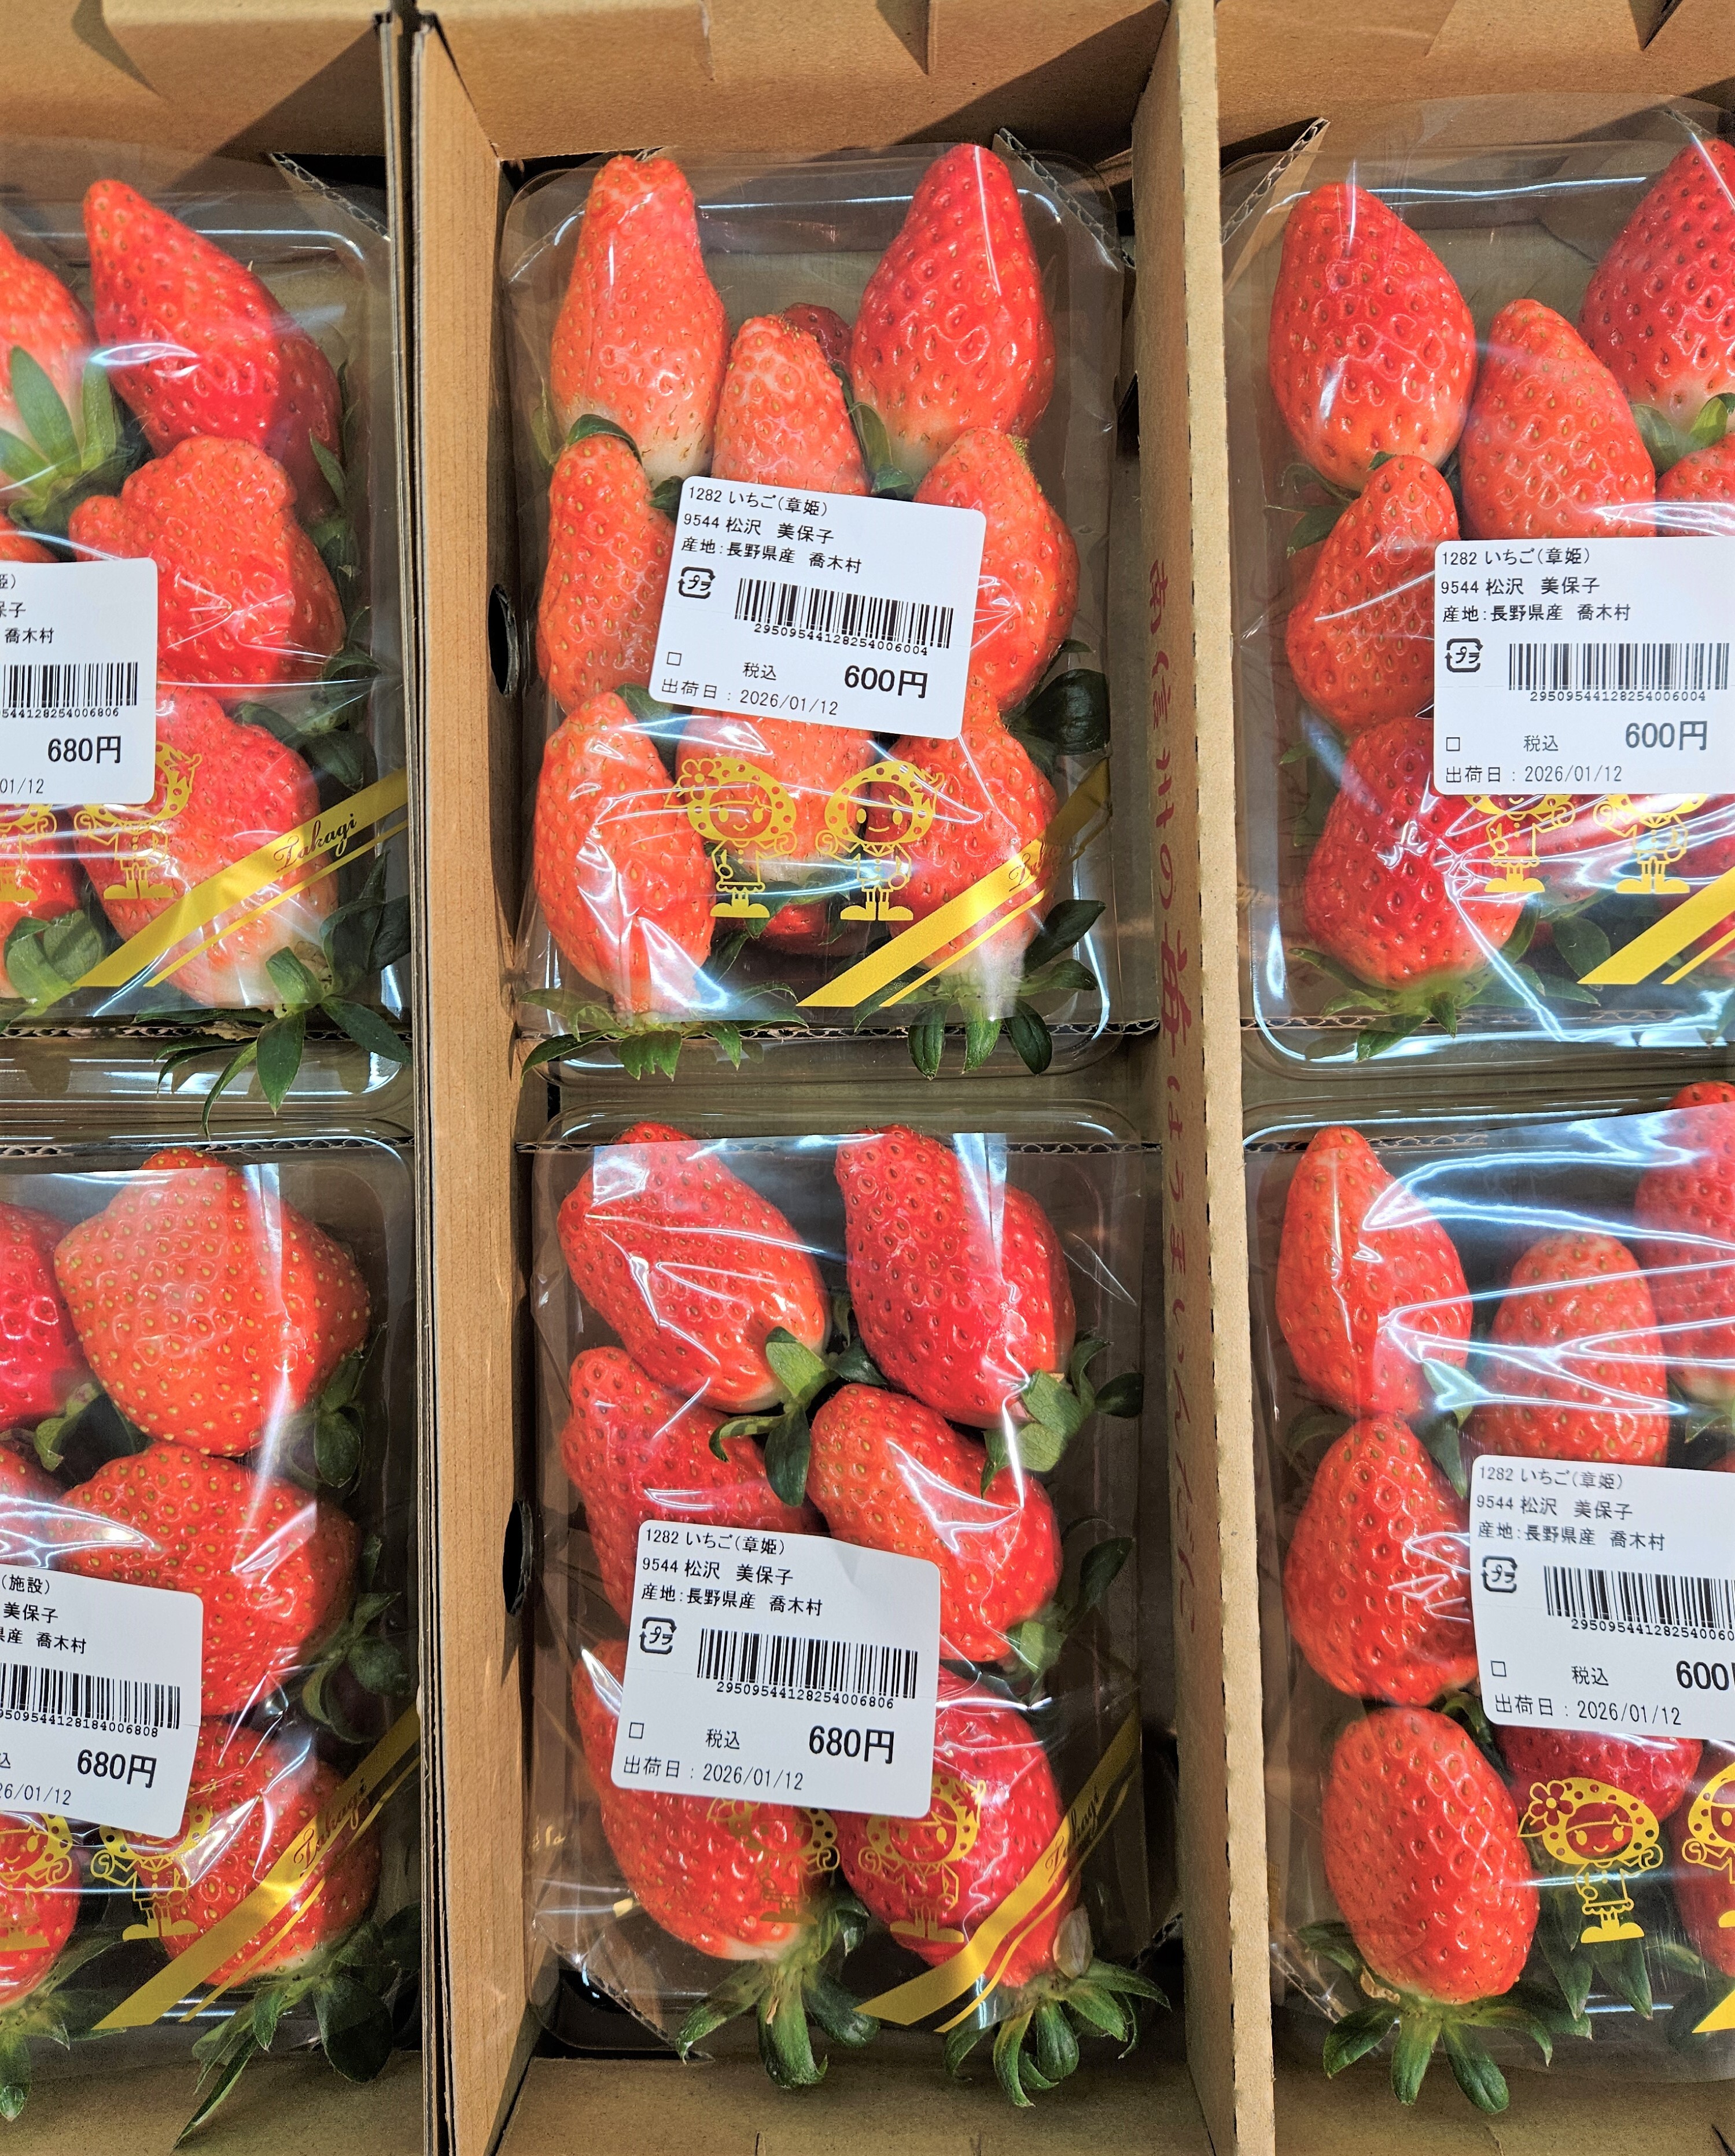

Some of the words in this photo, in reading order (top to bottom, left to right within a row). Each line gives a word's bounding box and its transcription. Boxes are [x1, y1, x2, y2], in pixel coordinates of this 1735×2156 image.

[690, 486, 722, 503] 1282
[683, 513, 720, 528] 9544
[725, 516, 761, 536] 松沢
[776, 522, 834, 544] 美保子
[809, 552, 862, 574] 喬木村
[1442, 551, 1477, 565] 1282
[1441, 580, 1479, 594] 9544
[1485, 577, 1524, 597] 松沢
[1541, 576, 1600, 595] 美保子
[1577, 604, 1631, 621] 喬木村
[5, 627, 54, 644] 喬木村
[754, 623, 928, 656] 29509544128254006004
[742, 662, 776, 681] 税込
[844, 665, 928, 699] 600円
[1530, 690, 1705, 702] 29509544128254006004
[1523, 734, 1559, 752] 税込
[1625, 720, 1708, 751] 600円
[47, 735, 121, 764] 680円
[274, 812, 357, 873] Takagi
[1480, 1466, 1513, 1481] 1282
[1476, 1495, 1514, 1510] 9544
[1520, 1496, 1557, 1516] 松沢
[1574, 1500, 1633, 1521] 美保子
[647, 1528, 679, 1544] 1282
[1609, 1530, 1665, 1551] 喬木村
[642, 1557, 679, 1573] 9544
[684, 1559, 720, 1580] 松沢
[736, 1563, 793, 1585] 美保子
[3, 1601, 58, 1624] 美保子
[769, 1595, 823, 1617] 喬木村
[36, 1631, 87, 1654] 喬木村
[1571, 1665, 1609, 1686] 税込
[1676, 1660, 1735, 1691] 600
[716, 1681, 894, 1709] 29509544128254006806
[705, 1728, 740, 1750] 税込
[809, 1725, 894, 1764] 680円
[77, 1749, 157, 1789] 680円
